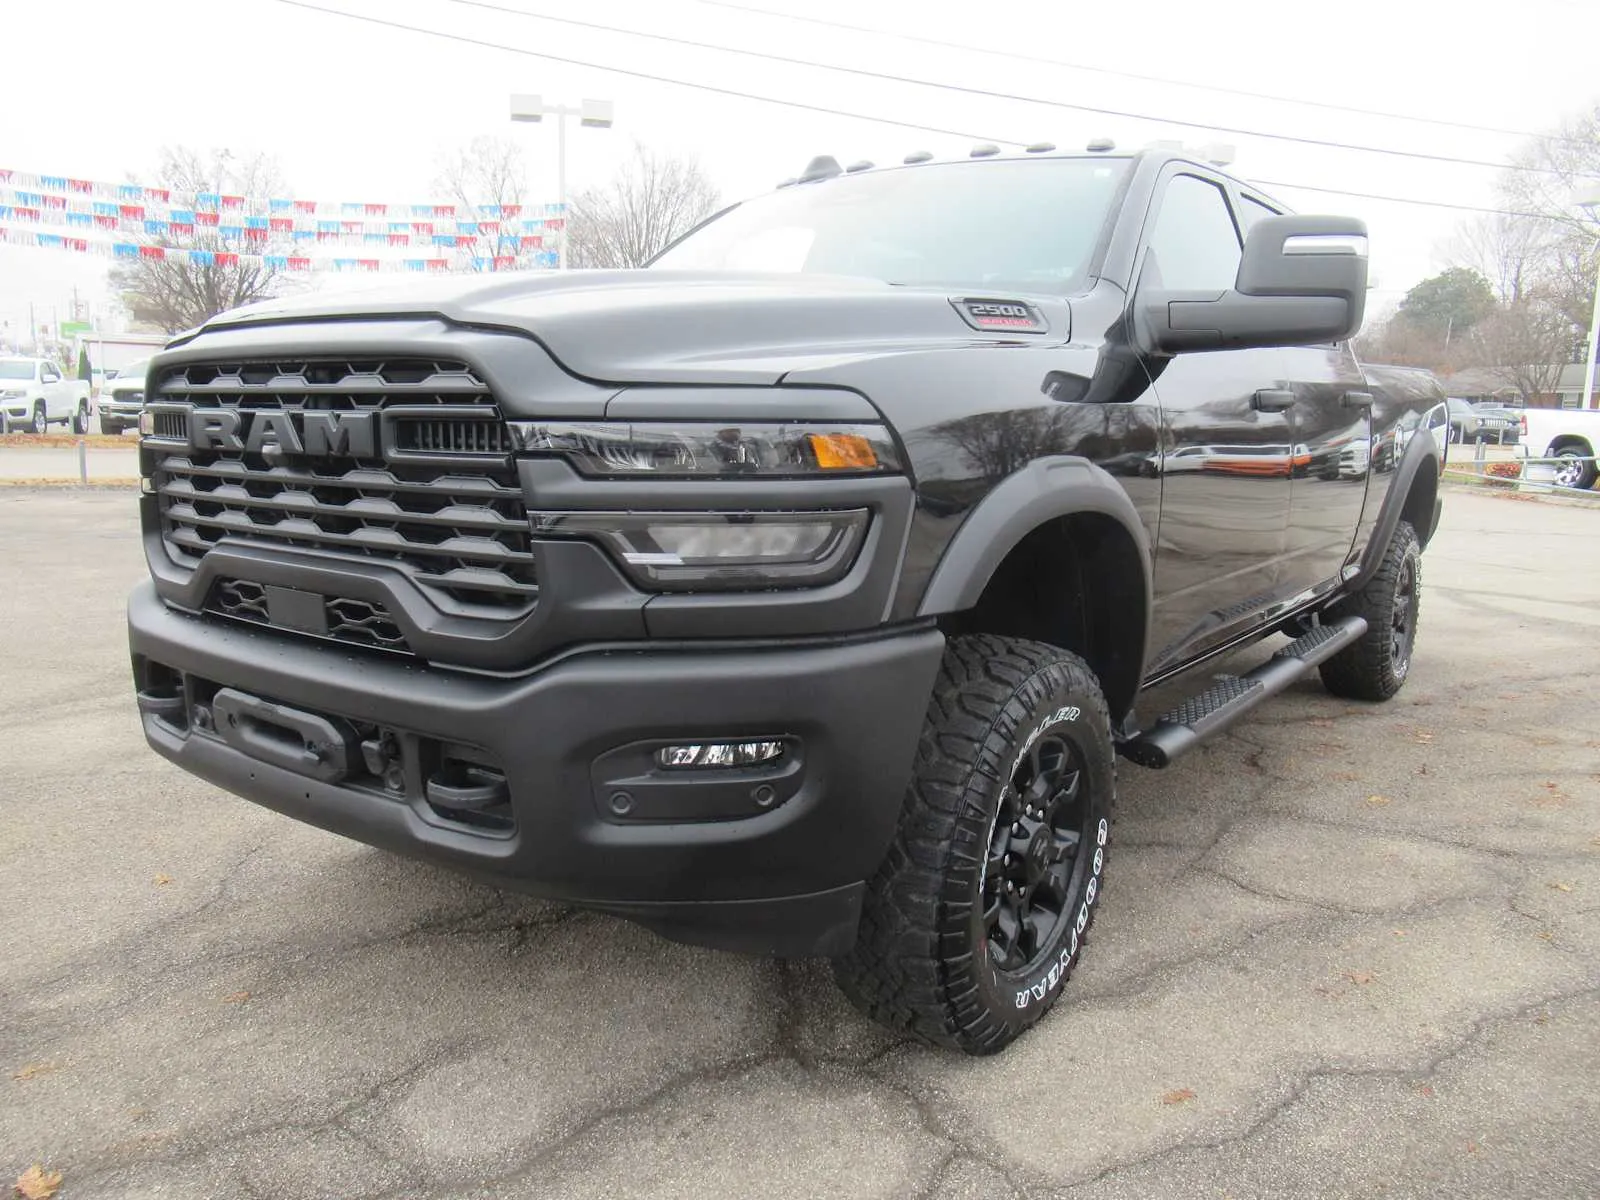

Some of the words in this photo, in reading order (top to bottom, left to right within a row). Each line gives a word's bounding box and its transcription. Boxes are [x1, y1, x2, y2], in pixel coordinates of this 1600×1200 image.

[971, 304, 1027, 318] 2500
[193, 408, 375, 458] RAM
[1015, 818, 1108, 1009] GOODYEAR
